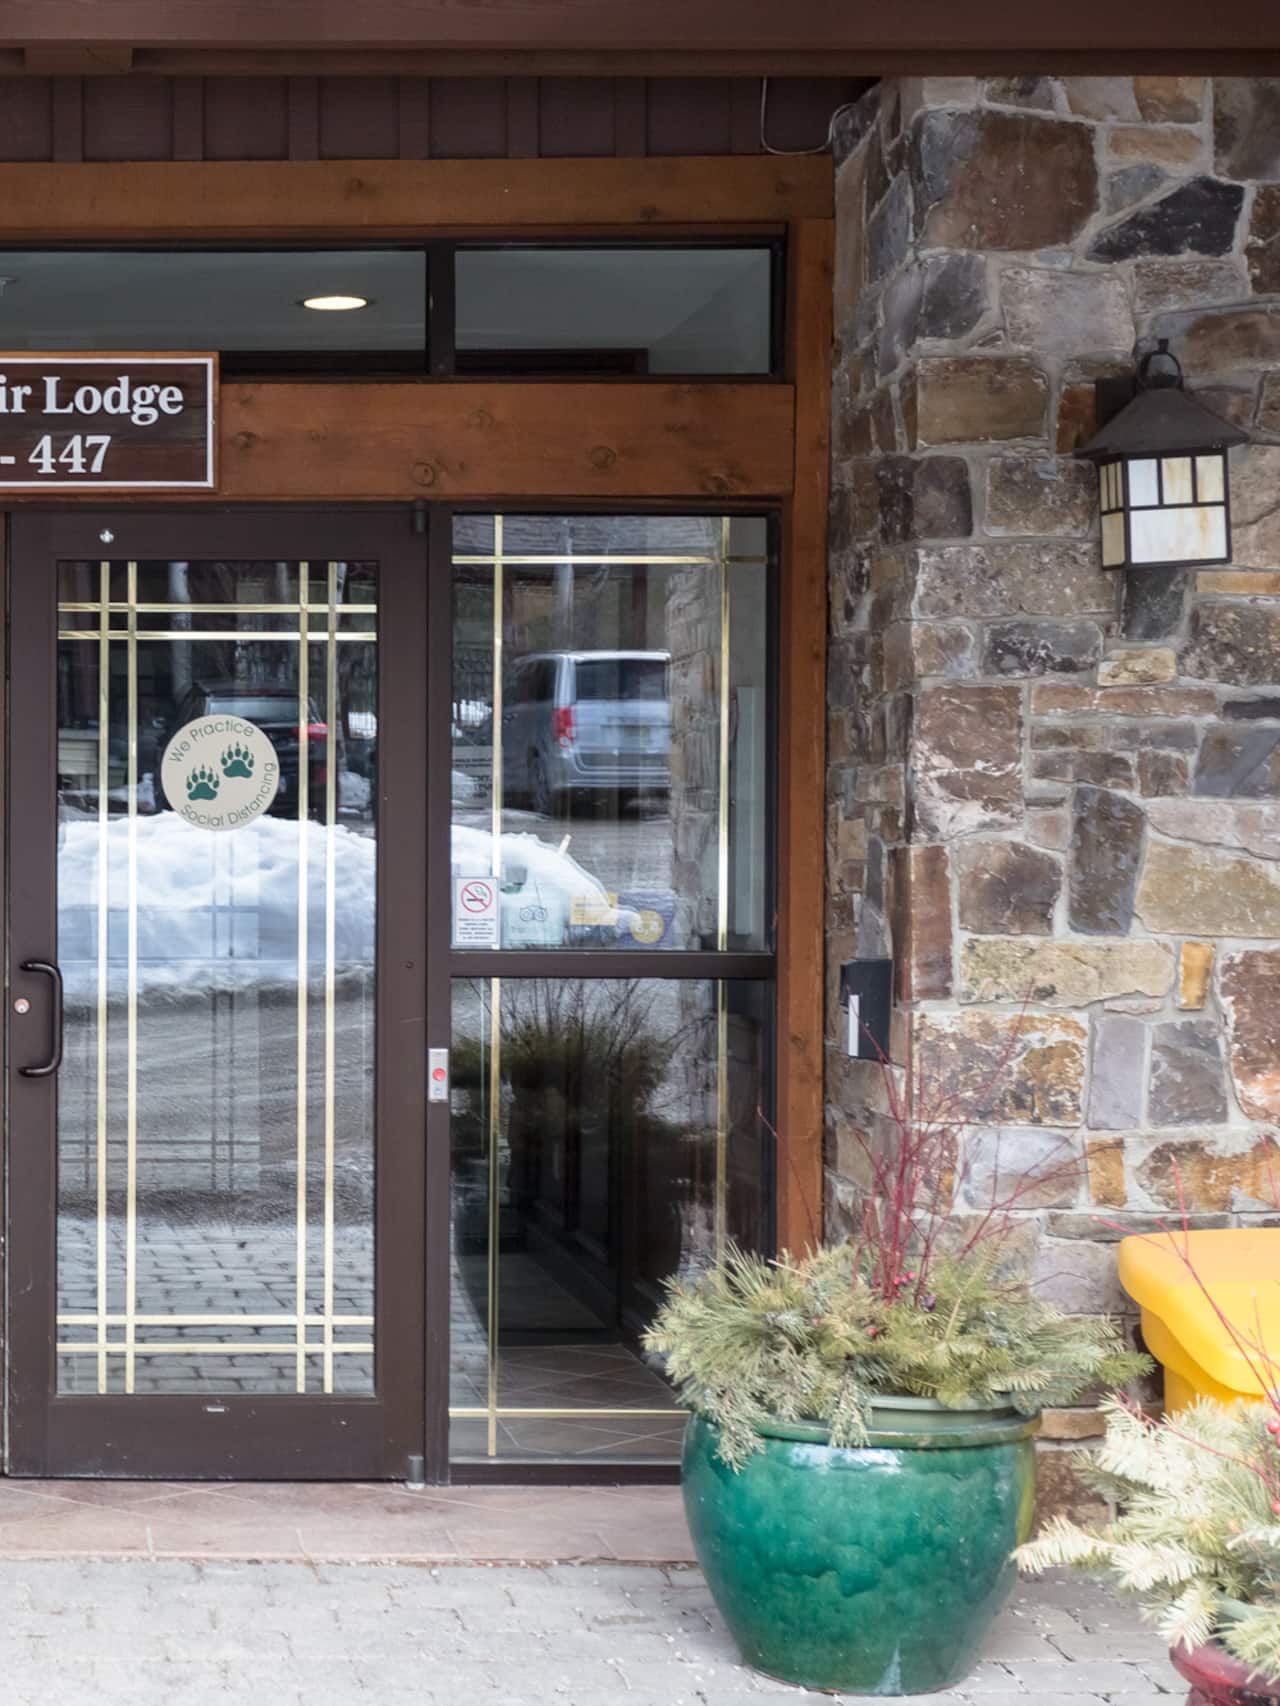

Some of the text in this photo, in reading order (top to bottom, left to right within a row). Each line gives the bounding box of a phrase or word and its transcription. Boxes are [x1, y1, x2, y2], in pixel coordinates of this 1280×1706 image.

[42, 375, 184, 425] Lodge
[0, 455, 16, 465] -
[28, 434, 111, 474] 447
[169, 720, 254, 762] We Practice
[181, 763, 276, 826] Social Distancing
